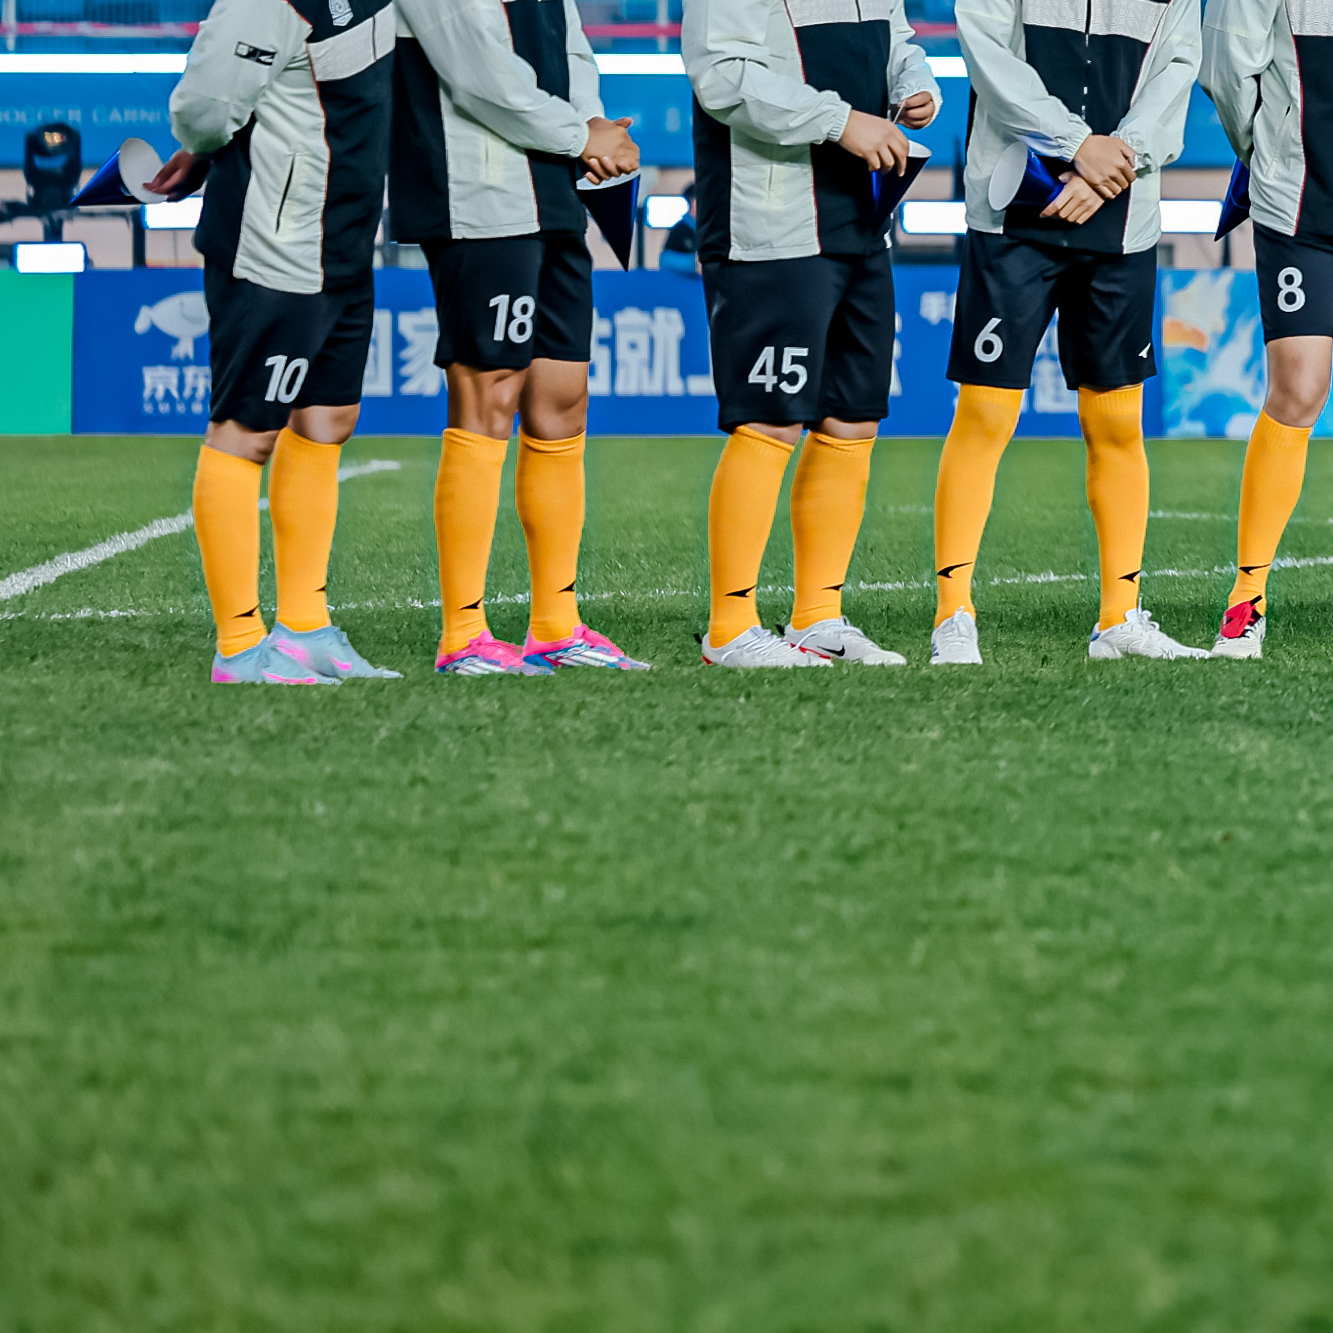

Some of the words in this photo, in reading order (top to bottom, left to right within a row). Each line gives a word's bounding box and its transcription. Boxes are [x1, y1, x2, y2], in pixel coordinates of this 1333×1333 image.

[1278, 267, 1305, 312] 8
[489, 295, 535, 343] 18
[974, 318, 1003, 363] 6
[265, 355, 309, 404] 10
[749, 347, 809, 394] 45
